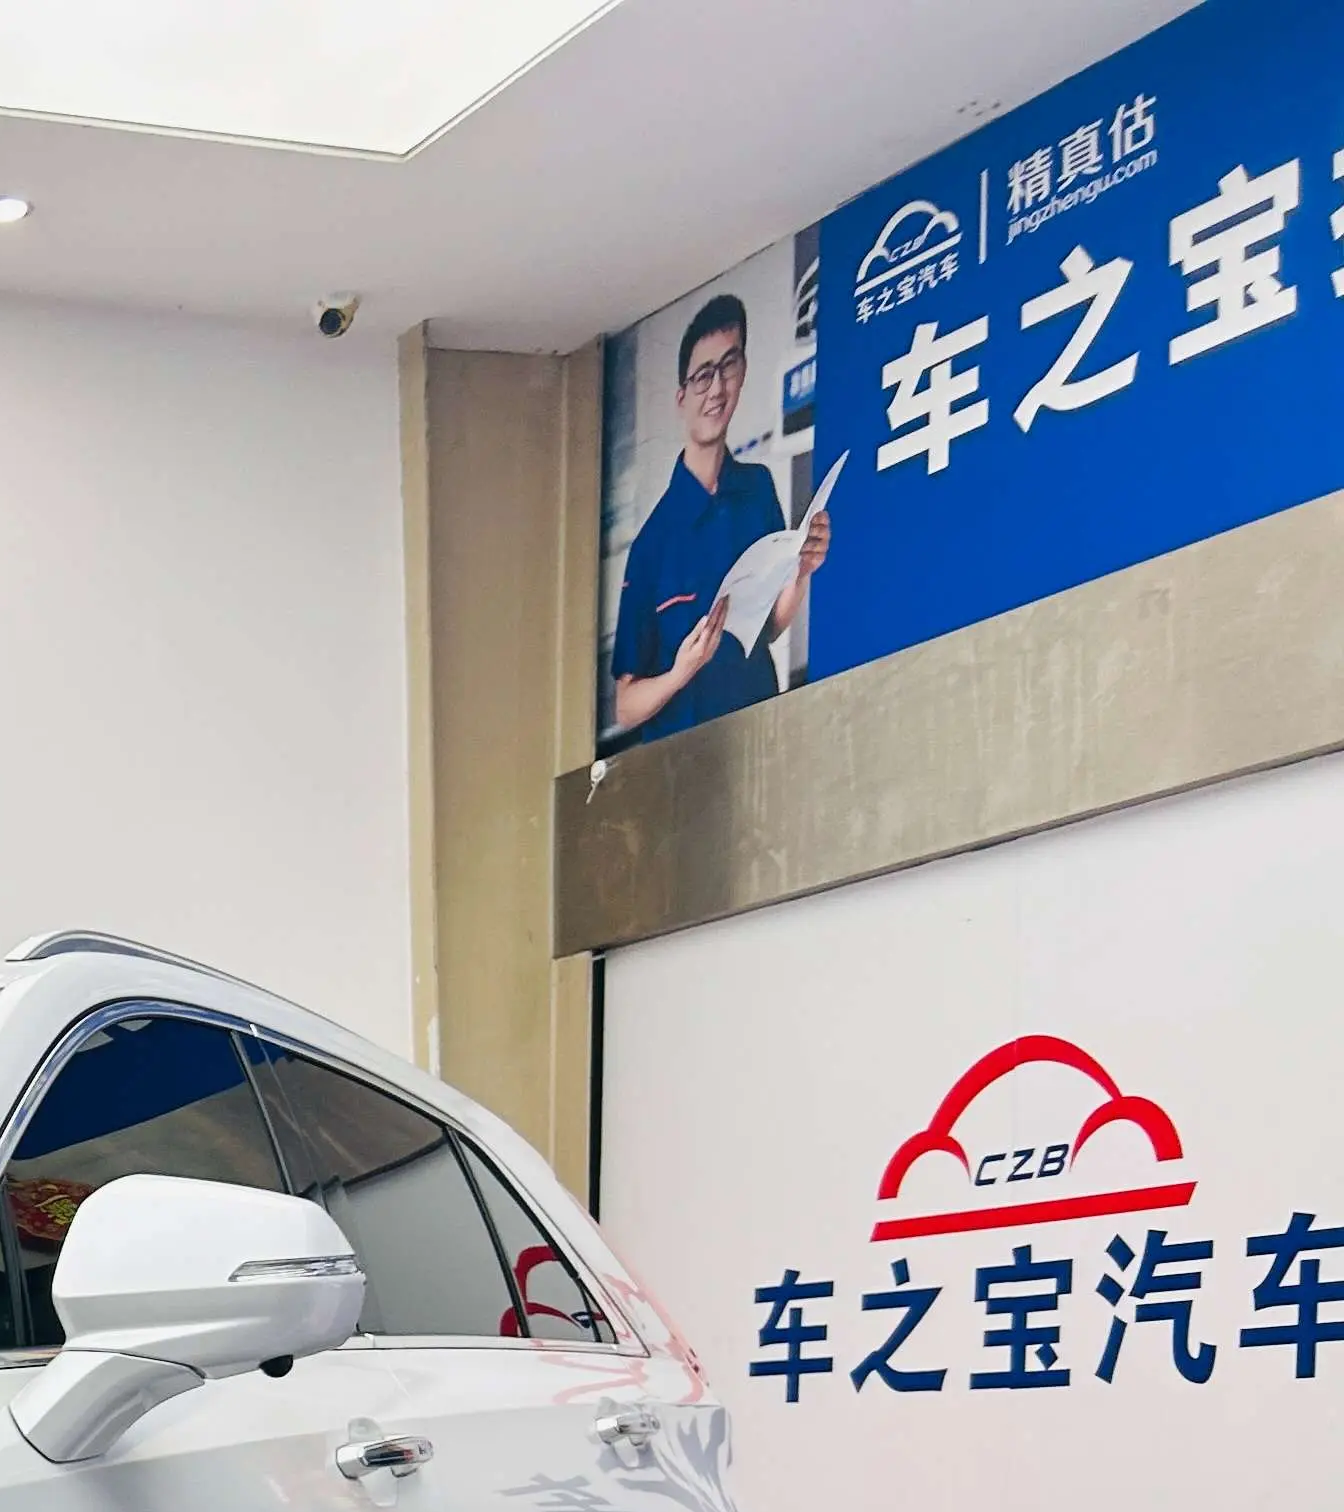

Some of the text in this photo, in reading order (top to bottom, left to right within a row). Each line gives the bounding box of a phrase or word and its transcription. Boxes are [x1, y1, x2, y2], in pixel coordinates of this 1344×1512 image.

[1005, 150, 1158, 246] jingzhengu.com
[1006, 93, 1157, 213] 精真估
[855, 251, 960, 323] 车之宝汽车
[876, 148, 1344, 476] 车之宝
[973, 1143, 1070, 1187] CZB
[749, 1211, 1344, 1403] 车之宝汽车
